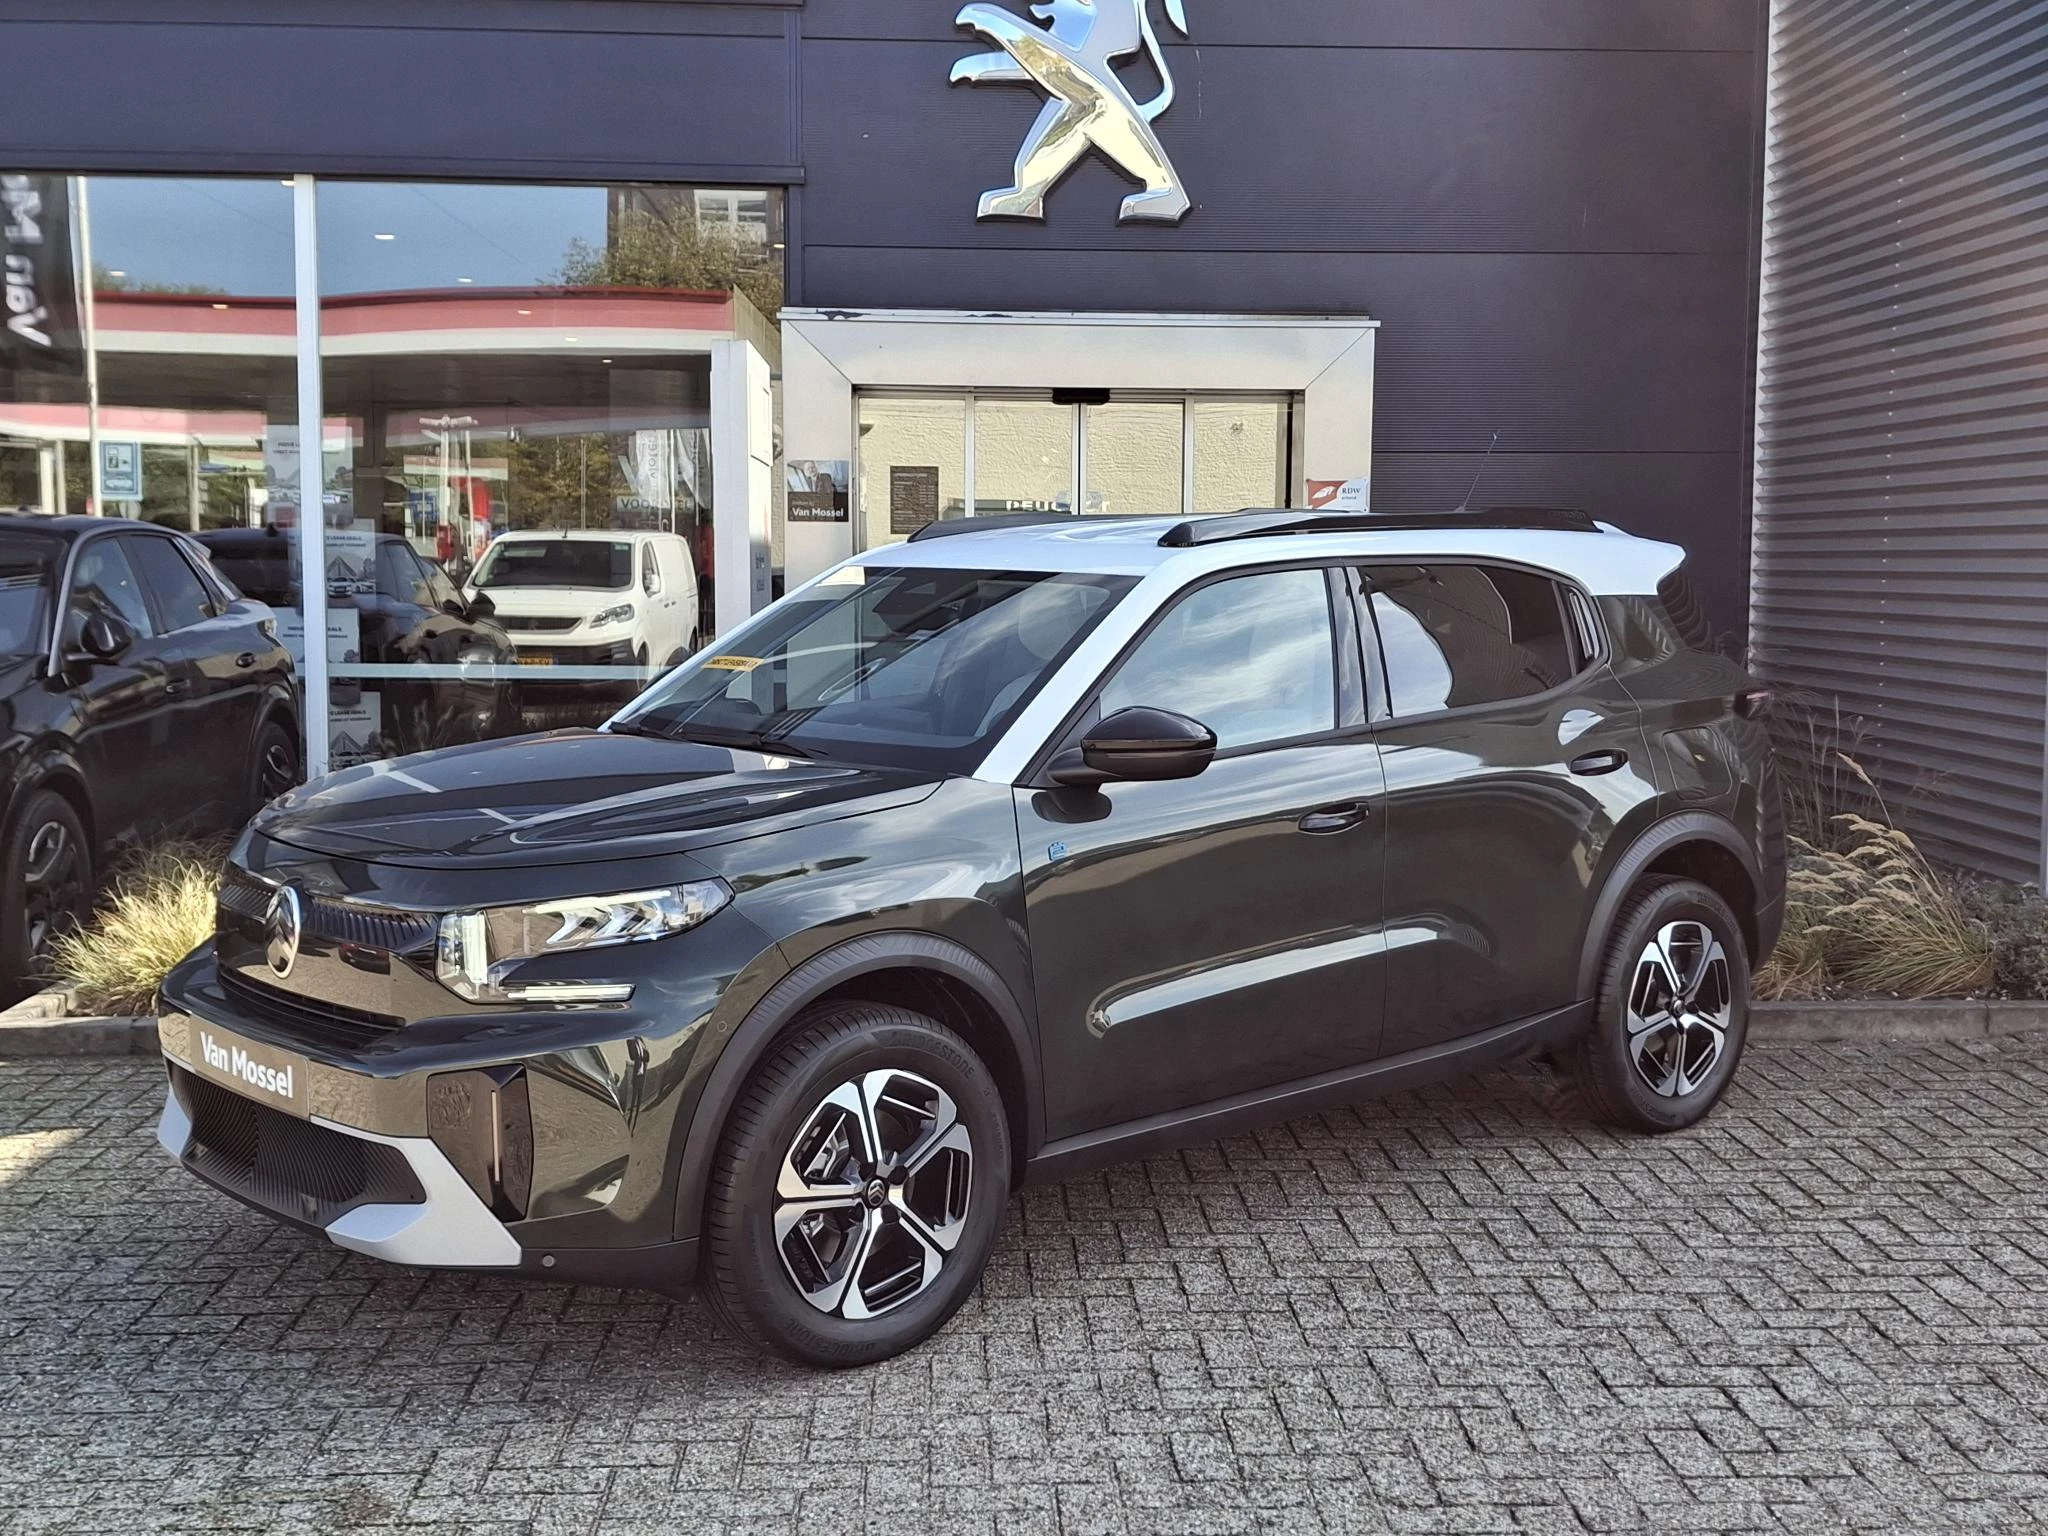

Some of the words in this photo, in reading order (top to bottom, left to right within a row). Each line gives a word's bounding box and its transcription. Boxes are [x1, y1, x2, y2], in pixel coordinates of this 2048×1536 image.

[792, 507, 809, 516] Van
[812, 507, 844, 517] Mossel
[200, 1030, 230, 1074] Van
[231, 1045, 294, 1098] Mossel
